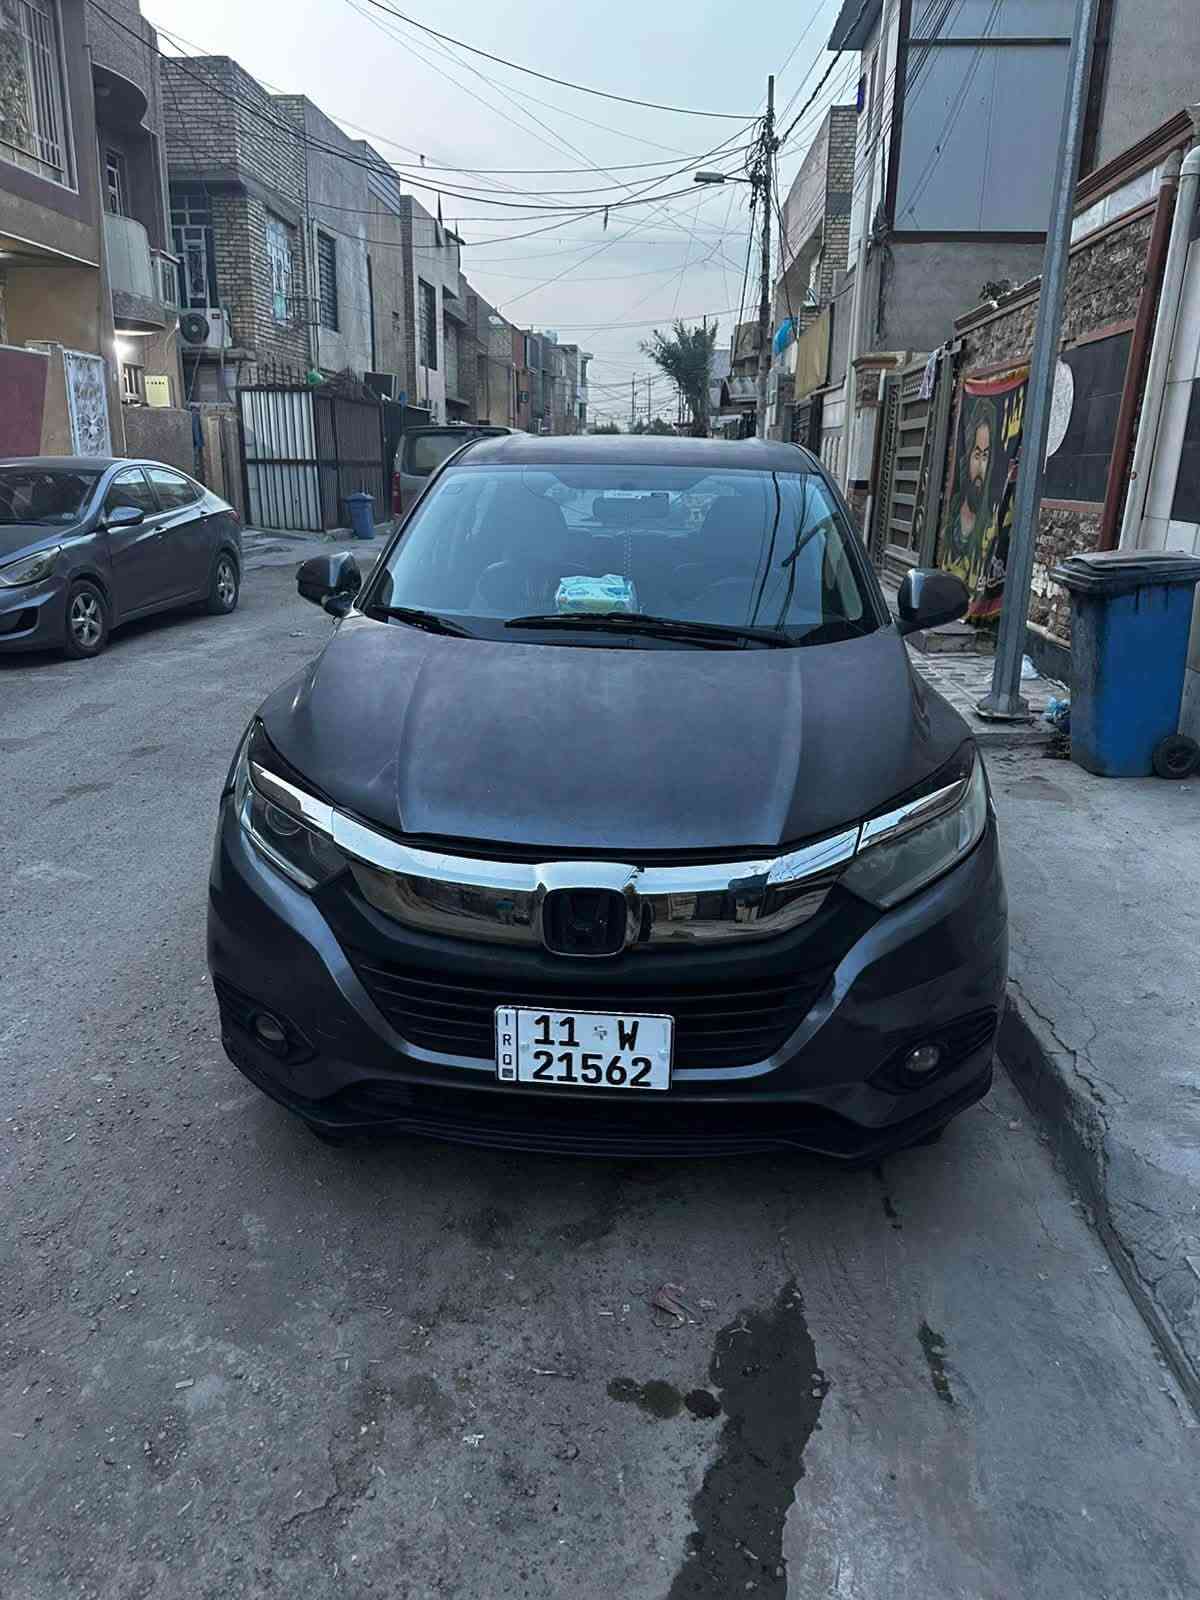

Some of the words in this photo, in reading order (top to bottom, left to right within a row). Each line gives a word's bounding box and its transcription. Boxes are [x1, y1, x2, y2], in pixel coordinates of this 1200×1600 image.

[534, 1014, 580, 1047] 11
[617, 1020, 639, 1051] W
[532, 1050, 652, 1087] 21562
